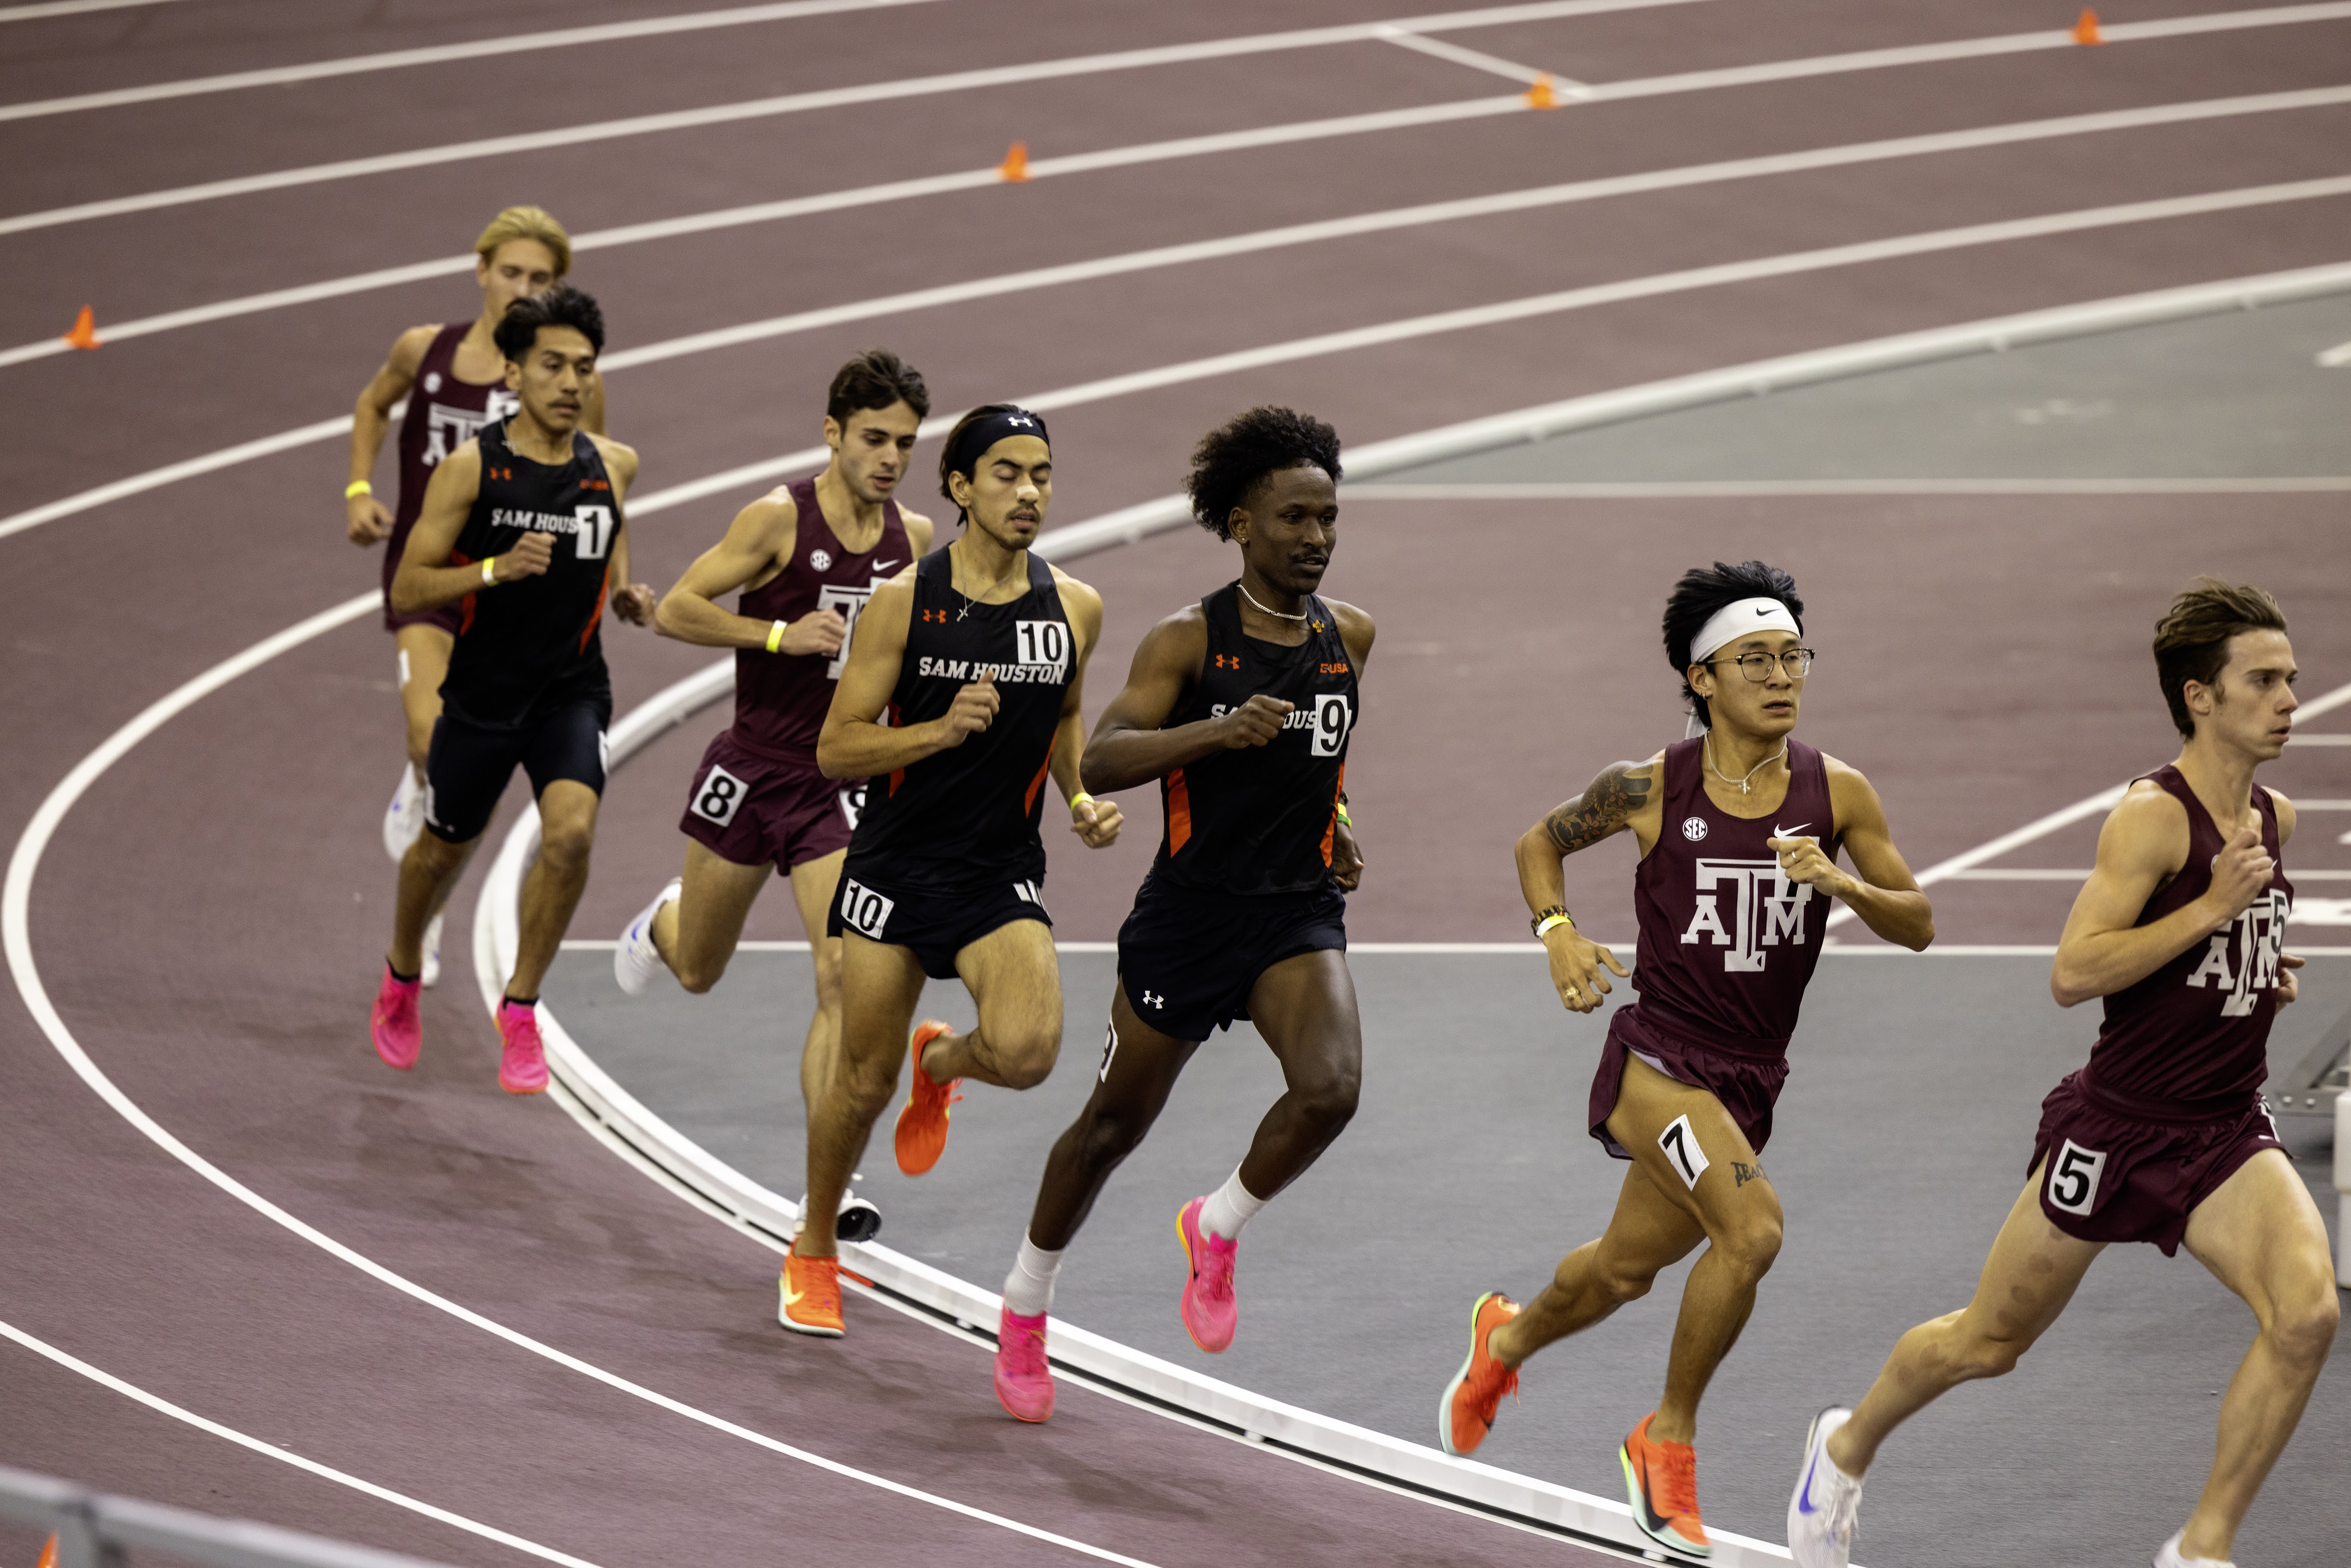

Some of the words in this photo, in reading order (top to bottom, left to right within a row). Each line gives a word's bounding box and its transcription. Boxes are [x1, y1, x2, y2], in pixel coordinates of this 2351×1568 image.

[492, 507, 534, 529] SAM
[533, 512, 579, 535] HOUS
[584, 511, 598, 555] 1
[1021, 623, 1062, 662] 10
[919, 656, 969, 680] SAM
[970, 662, 1066, 686] HOUSTON
[1320, 699, 1345, 752] 9
[701, 775, 736, 818] 8
[1685, 818, 1706, 839] SEC
[847, 884, 883, 932] 10
[2271, 894, 2287, 954] 5
[1662, 1122, 1696, 1182] 7
[2054, 1147, 2096, 1207] 5
